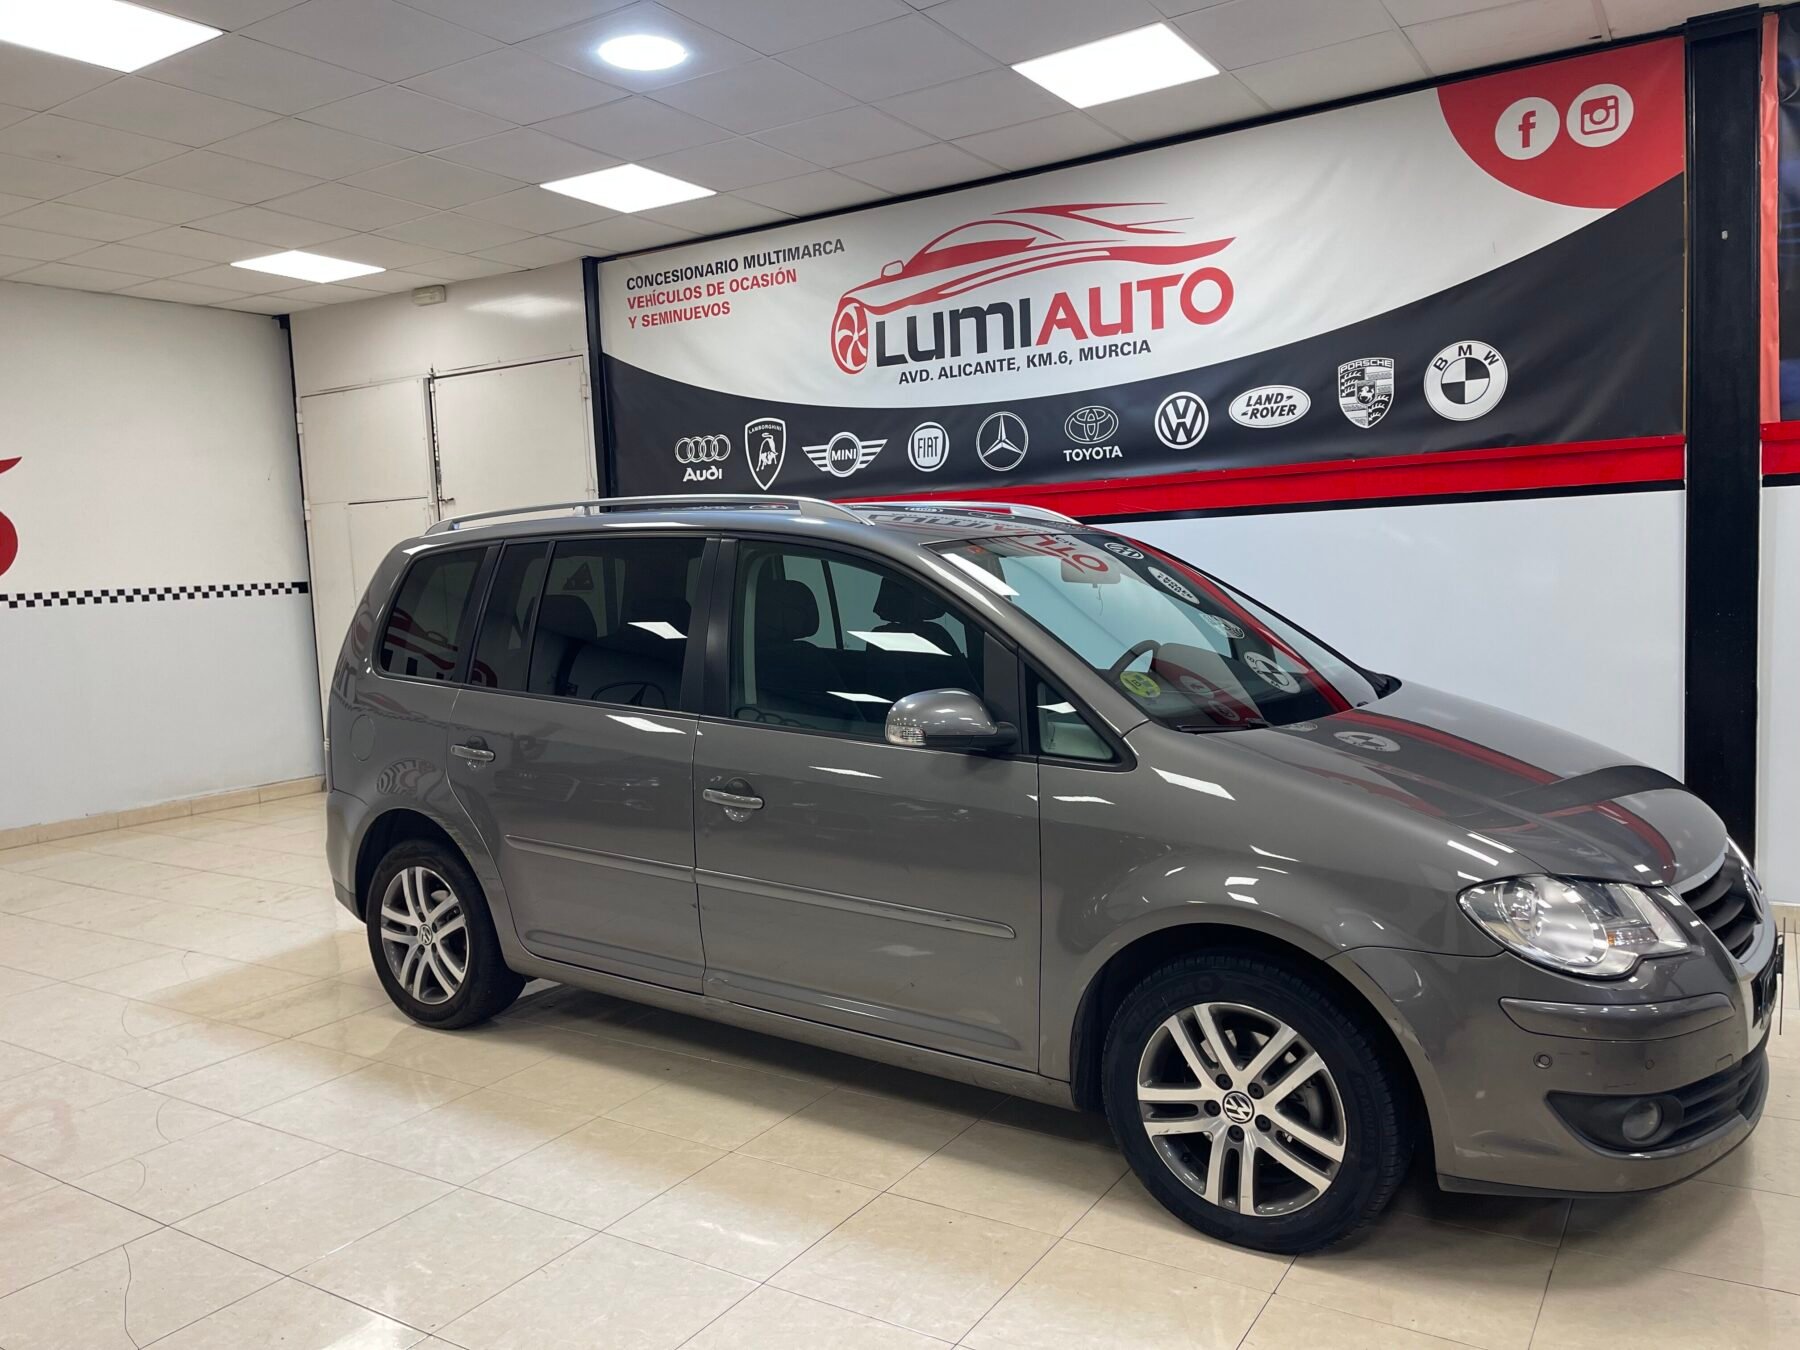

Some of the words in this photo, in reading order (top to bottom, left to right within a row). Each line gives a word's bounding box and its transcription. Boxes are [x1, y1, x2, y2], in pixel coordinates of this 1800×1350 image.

[626, 258, 739, 290] CONCESIONARIO
[743, 238, 845, 270] MULTIMARCA
[627, 285, 702, 310] VEHÍCULOS
[706, 281, 725, 298] DE
[729, 267, 797, 293] OCASIÓN
[628, 316, 638, 329] Y
[641, 301, 731, 328] SEMINUEVOS
[898, 366, 934, 384] AVD.
[938, 357, 1021, 380] ALICANTE,
[1026, 350, 1073, 369] KM.6,
[1079, 339, 1152, 362] MURCIA
[1340, 359, 1392, 373] PORSCHE
[1433, 344, 1500, 372] BMW
[831, 448, 857, 461] MINI
[917, 436, 940, 459] FIAT
[1063, 445, 1123, 462] TOYOTA
[682, 466, 723, 482] Audi
